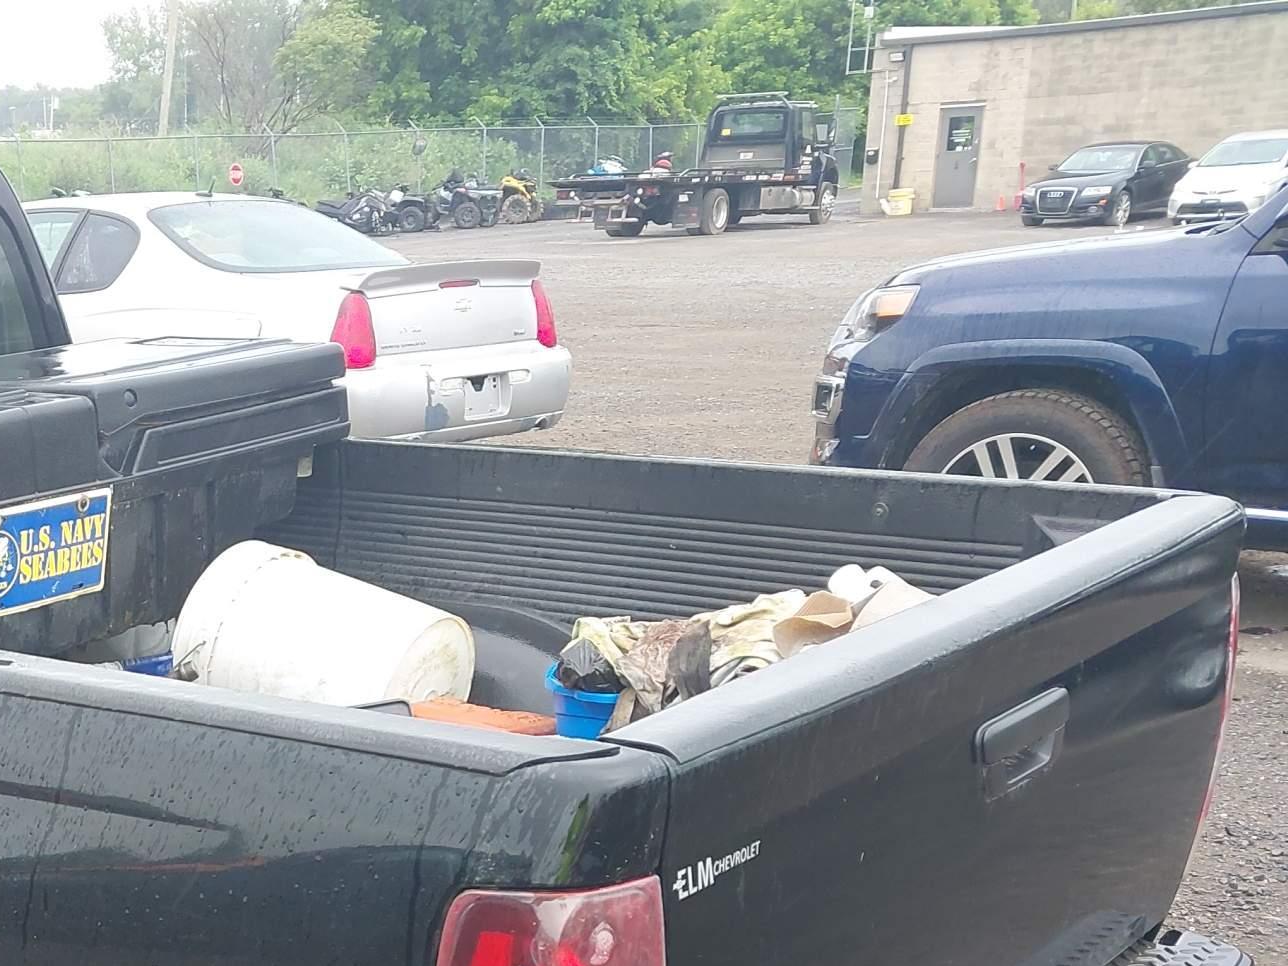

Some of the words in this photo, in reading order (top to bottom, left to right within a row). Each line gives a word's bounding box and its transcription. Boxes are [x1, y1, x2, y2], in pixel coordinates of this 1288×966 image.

[20, 525, 56, 555] U.S.
[60, 513, 106, 547] NAVY
[19, 538, 105, 585] SEABEES
[673, 856, 715, 901] ELM
[713, 840, 761, 876] CHEVROLET
